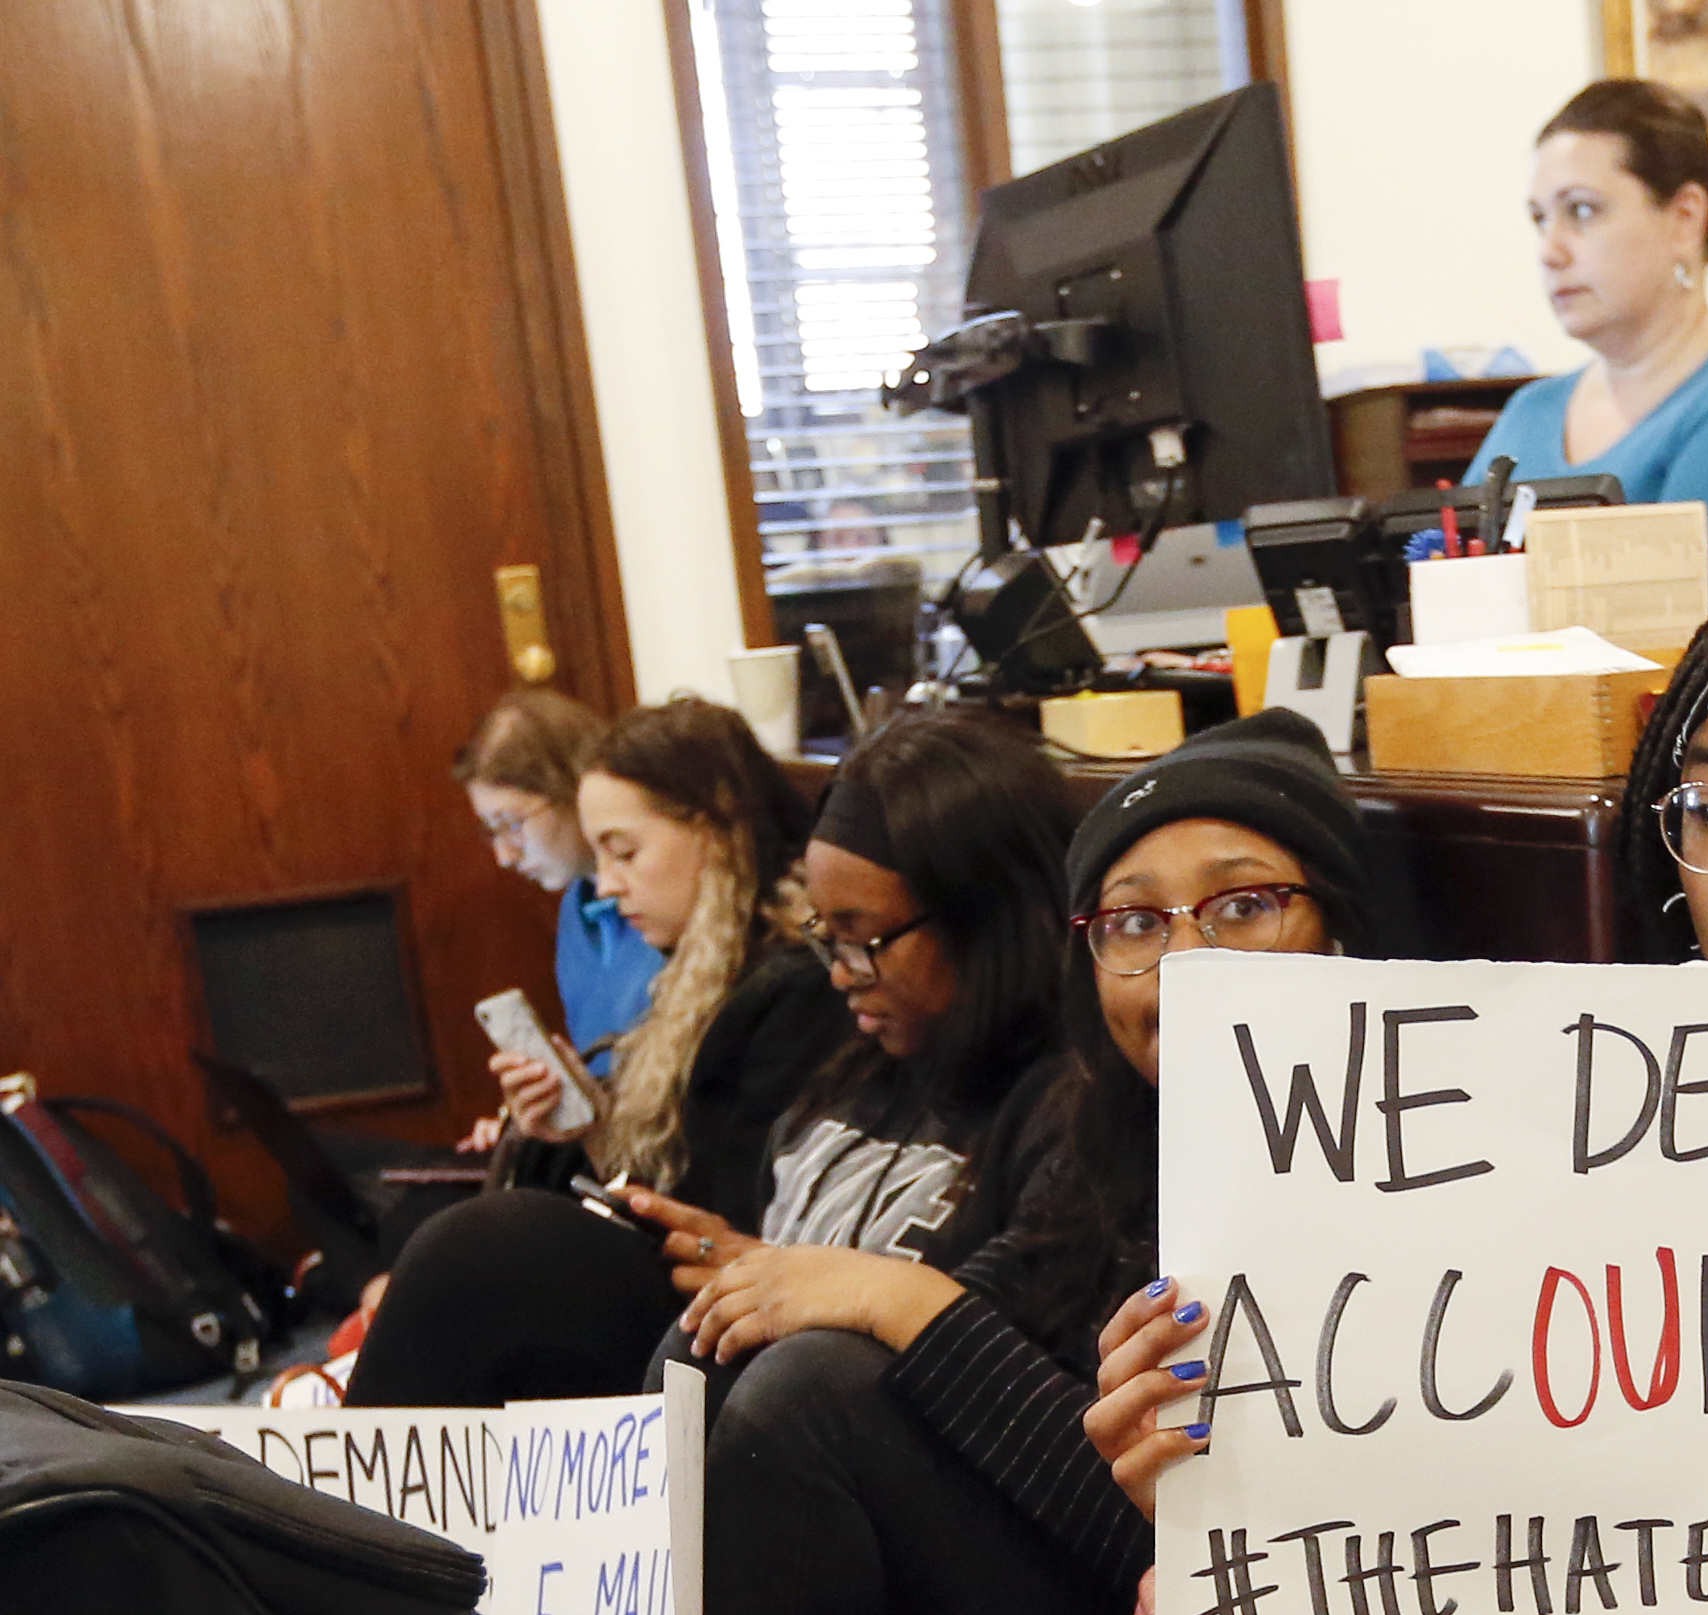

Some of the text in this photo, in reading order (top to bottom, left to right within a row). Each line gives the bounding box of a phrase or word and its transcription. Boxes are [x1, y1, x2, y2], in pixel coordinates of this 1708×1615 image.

[1233, 1002, 1495, 1192] WE
[258, 1421, 502, 1534] DEMAND
[504, 1405, 664, 1522] NO MORE
